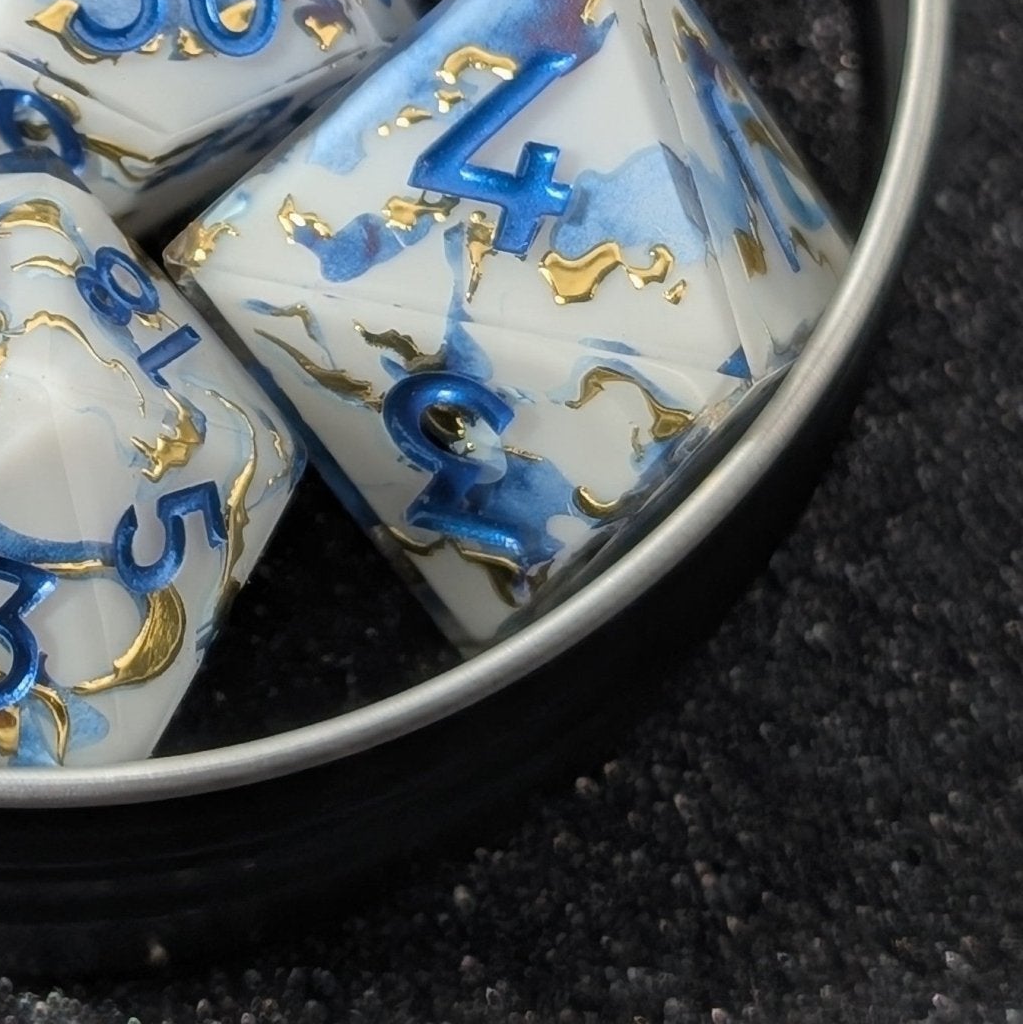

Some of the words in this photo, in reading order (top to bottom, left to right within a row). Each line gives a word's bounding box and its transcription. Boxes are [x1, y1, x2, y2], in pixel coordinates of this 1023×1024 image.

[407, 50, 577, 255] 4
[75, 246, 202, 389] 18
[113, 481, 229, 592] 5
